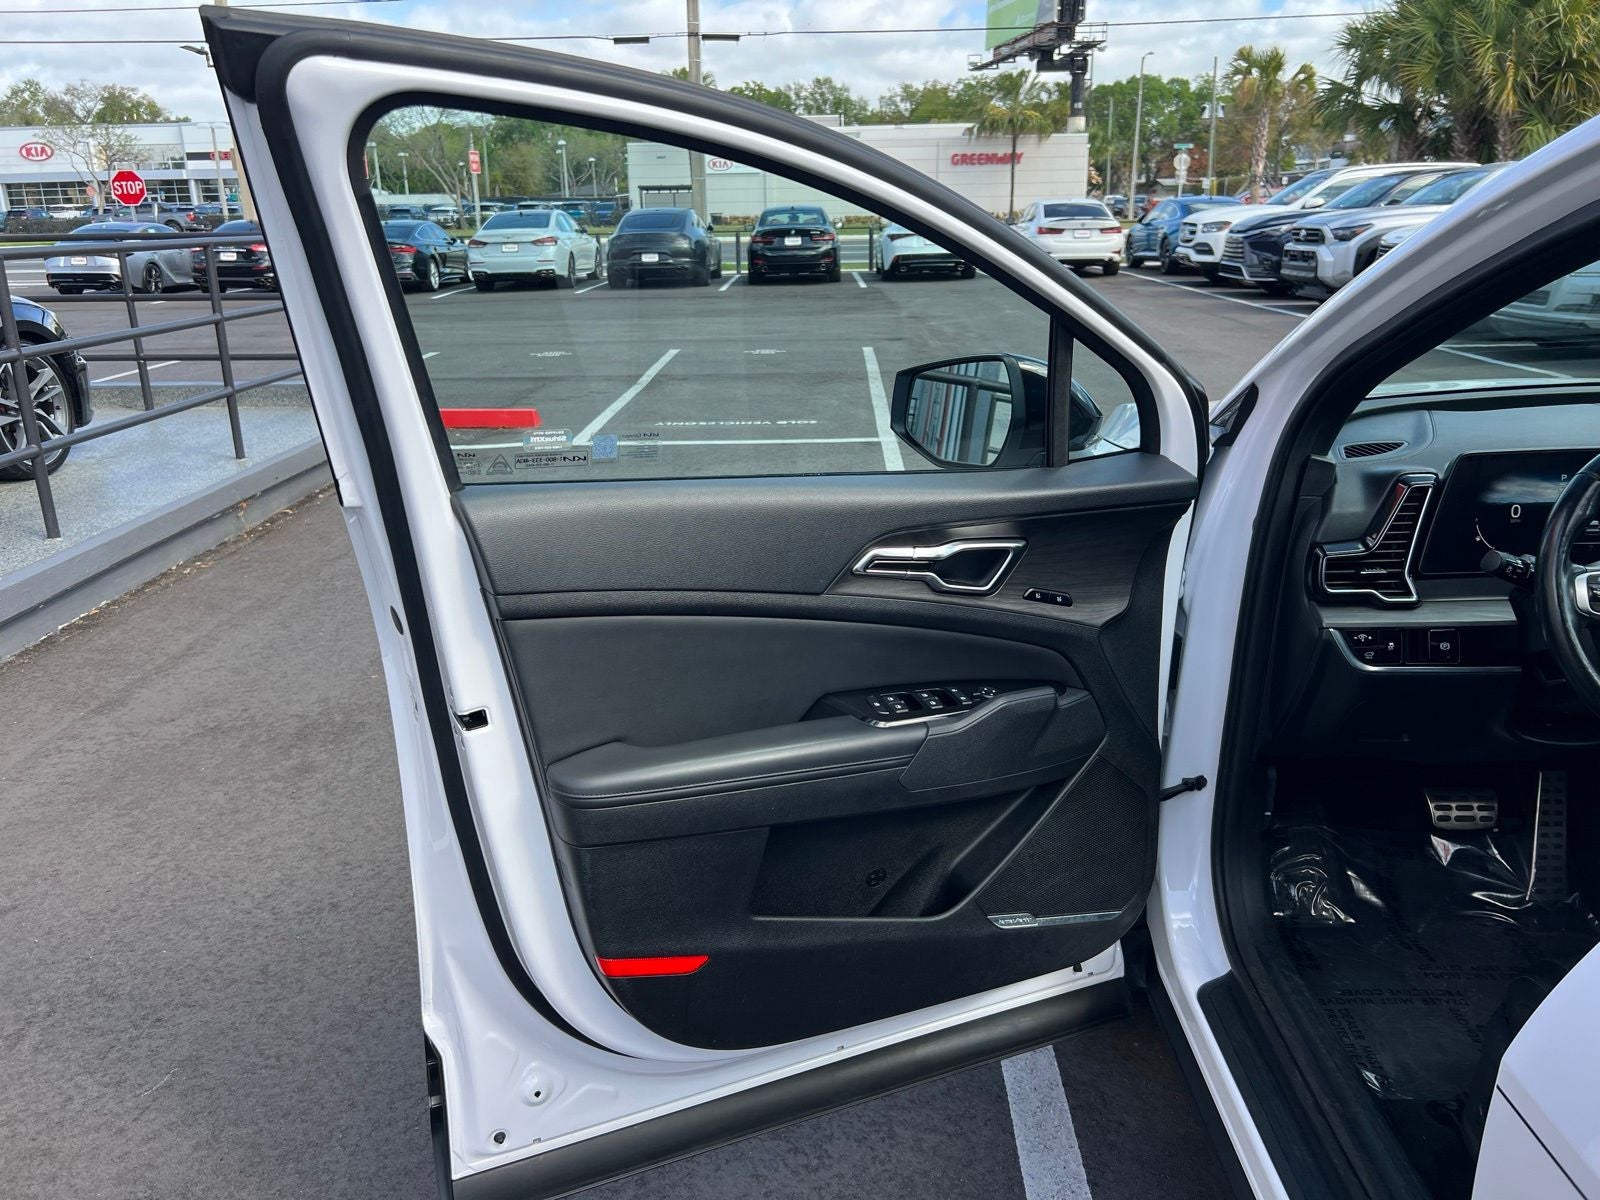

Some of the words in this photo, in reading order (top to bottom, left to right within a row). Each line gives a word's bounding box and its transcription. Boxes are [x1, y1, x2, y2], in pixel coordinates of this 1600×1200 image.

[24, 147, 49, 159] KIA
[950, 152, 1025, 167] GREENWAY
[711, 159, 729, 169] KIA
[113, 181, 143, 196] STOP
[1510, 504, 1522, 519] 0
